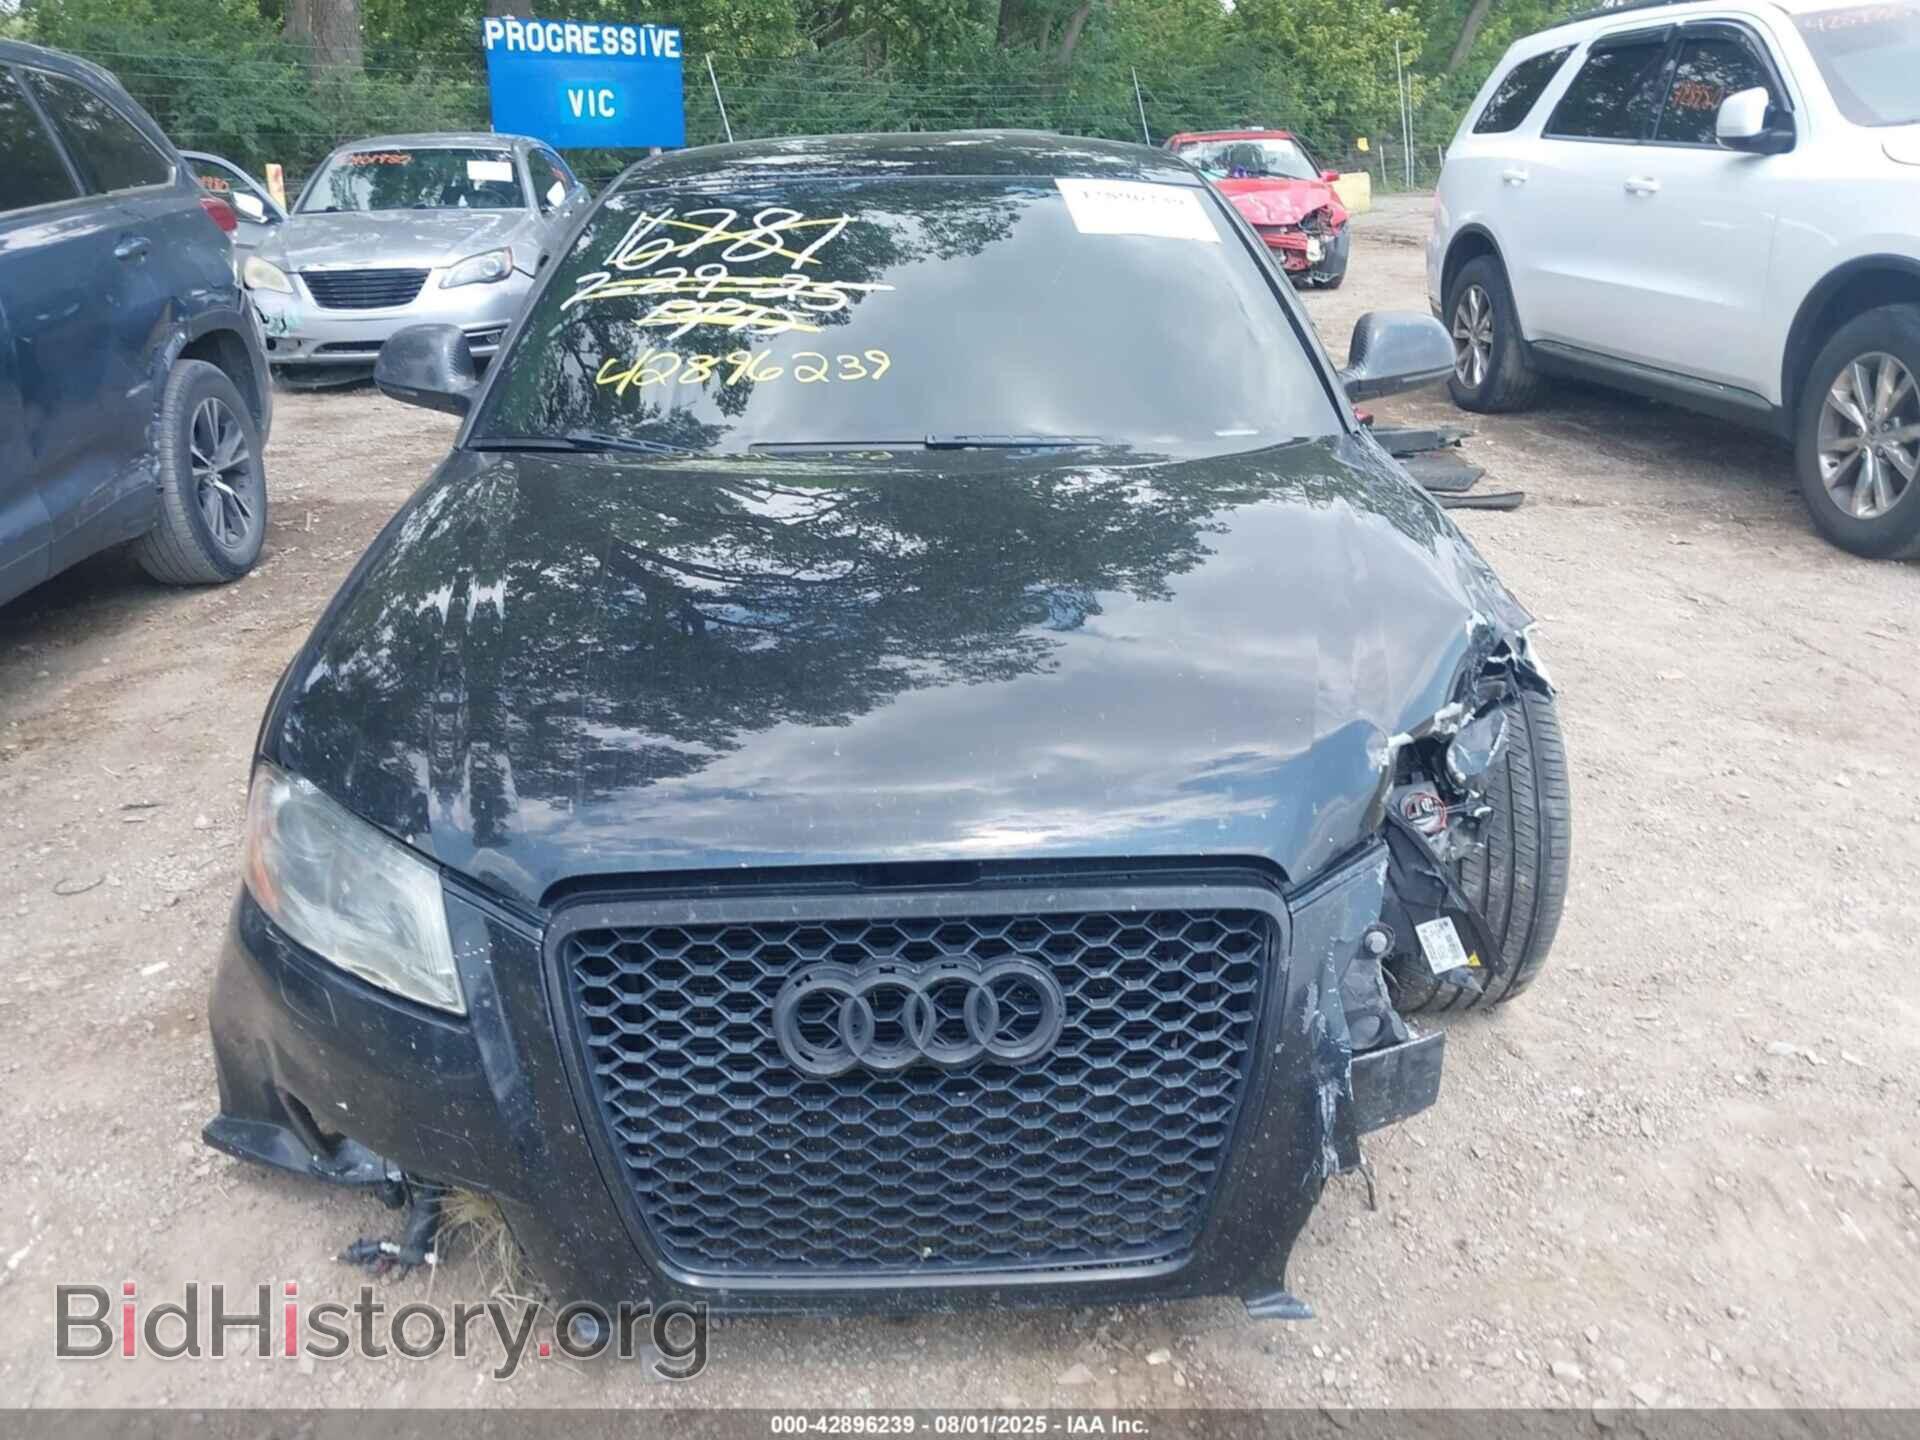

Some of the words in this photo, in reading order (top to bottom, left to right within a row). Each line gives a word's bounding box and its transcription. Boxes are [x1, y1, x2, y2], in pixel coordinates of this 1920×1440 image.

[484, 20, 681, 58] PROGRESSIVE
[567, 89, 615, 118] VIC
[595, 349, 891, 396] 42896239
